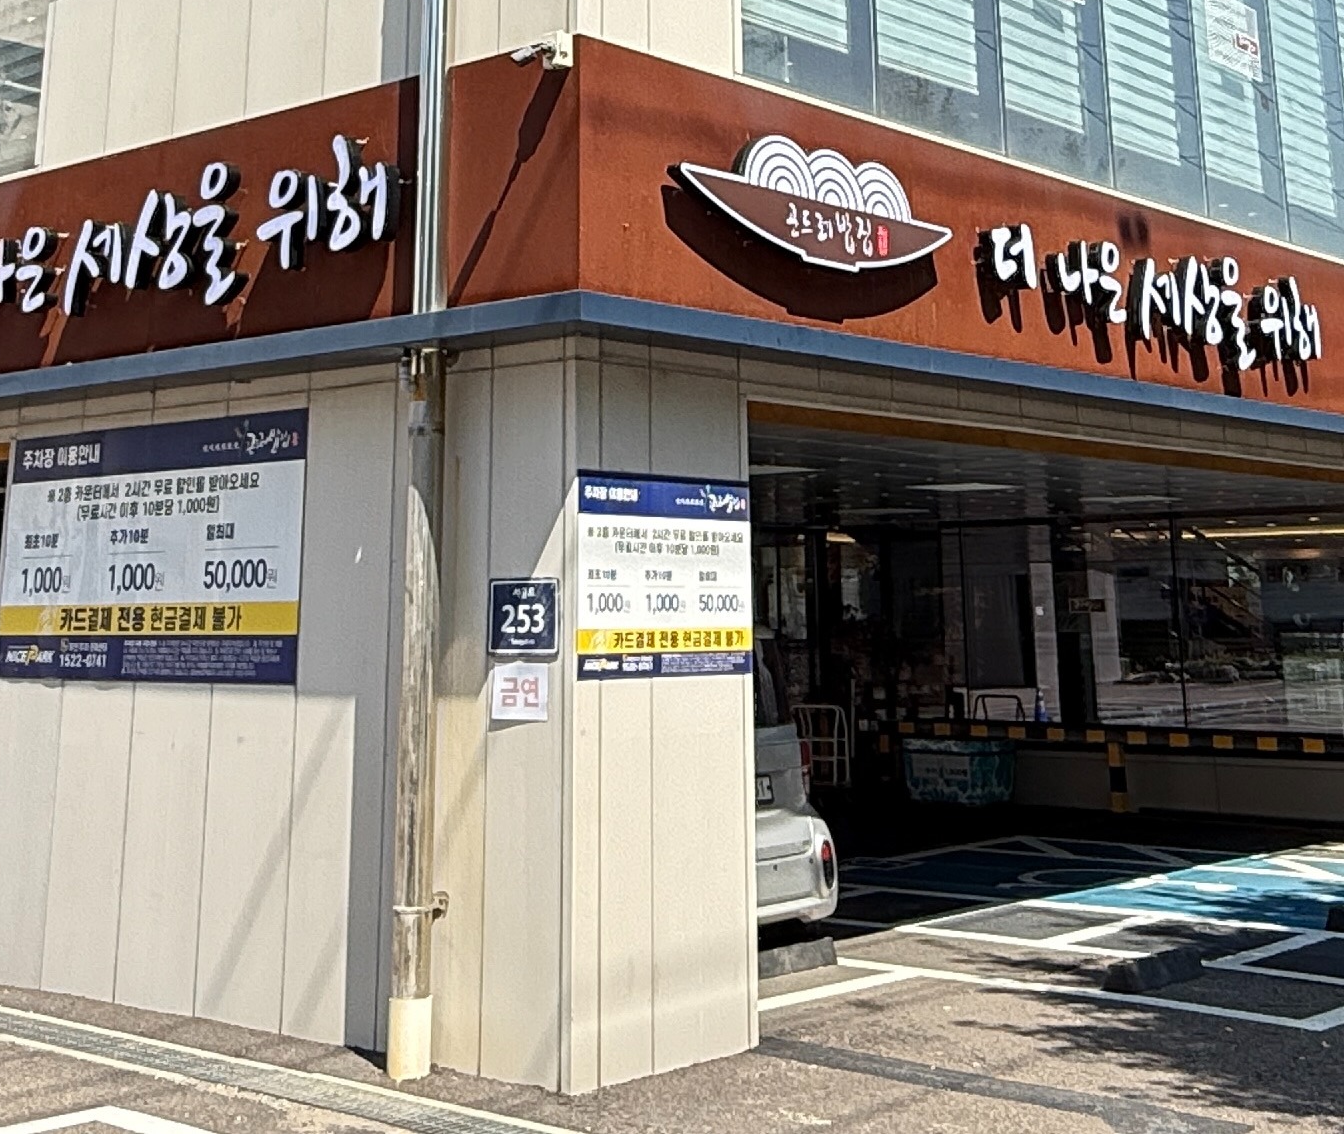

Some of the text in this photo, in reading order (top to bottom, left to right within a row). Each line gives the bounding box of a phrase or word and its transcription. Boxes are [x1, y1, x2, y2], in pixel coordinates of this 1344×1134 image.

[64, 162, 237, 316] 세상을
[257, 134, 388, 268] 위해
[786, 202, 874, 258] 곤드레밥집
[994, 223, 1323, 370] 더 나은 세상을 위해
[22, 443, 101, 470] 주차장 이용안내
[75, 483, 120, 502] 카운터에서
[125, 480, 152, 498] 2시간
[154, 478, 174, 496] 무료
[176, 476, 206, 495] 할인을
[208, 472, 261, 493] 받아오세요
[77, 495, 221, 522] (무료시간 이후 10분당 1,000원)
[59, 605, 243, 633] 카드결제 전용 현금결제 불가
[501, 603, 545, 633] 253
[500, 676, 540, 708] 금연
